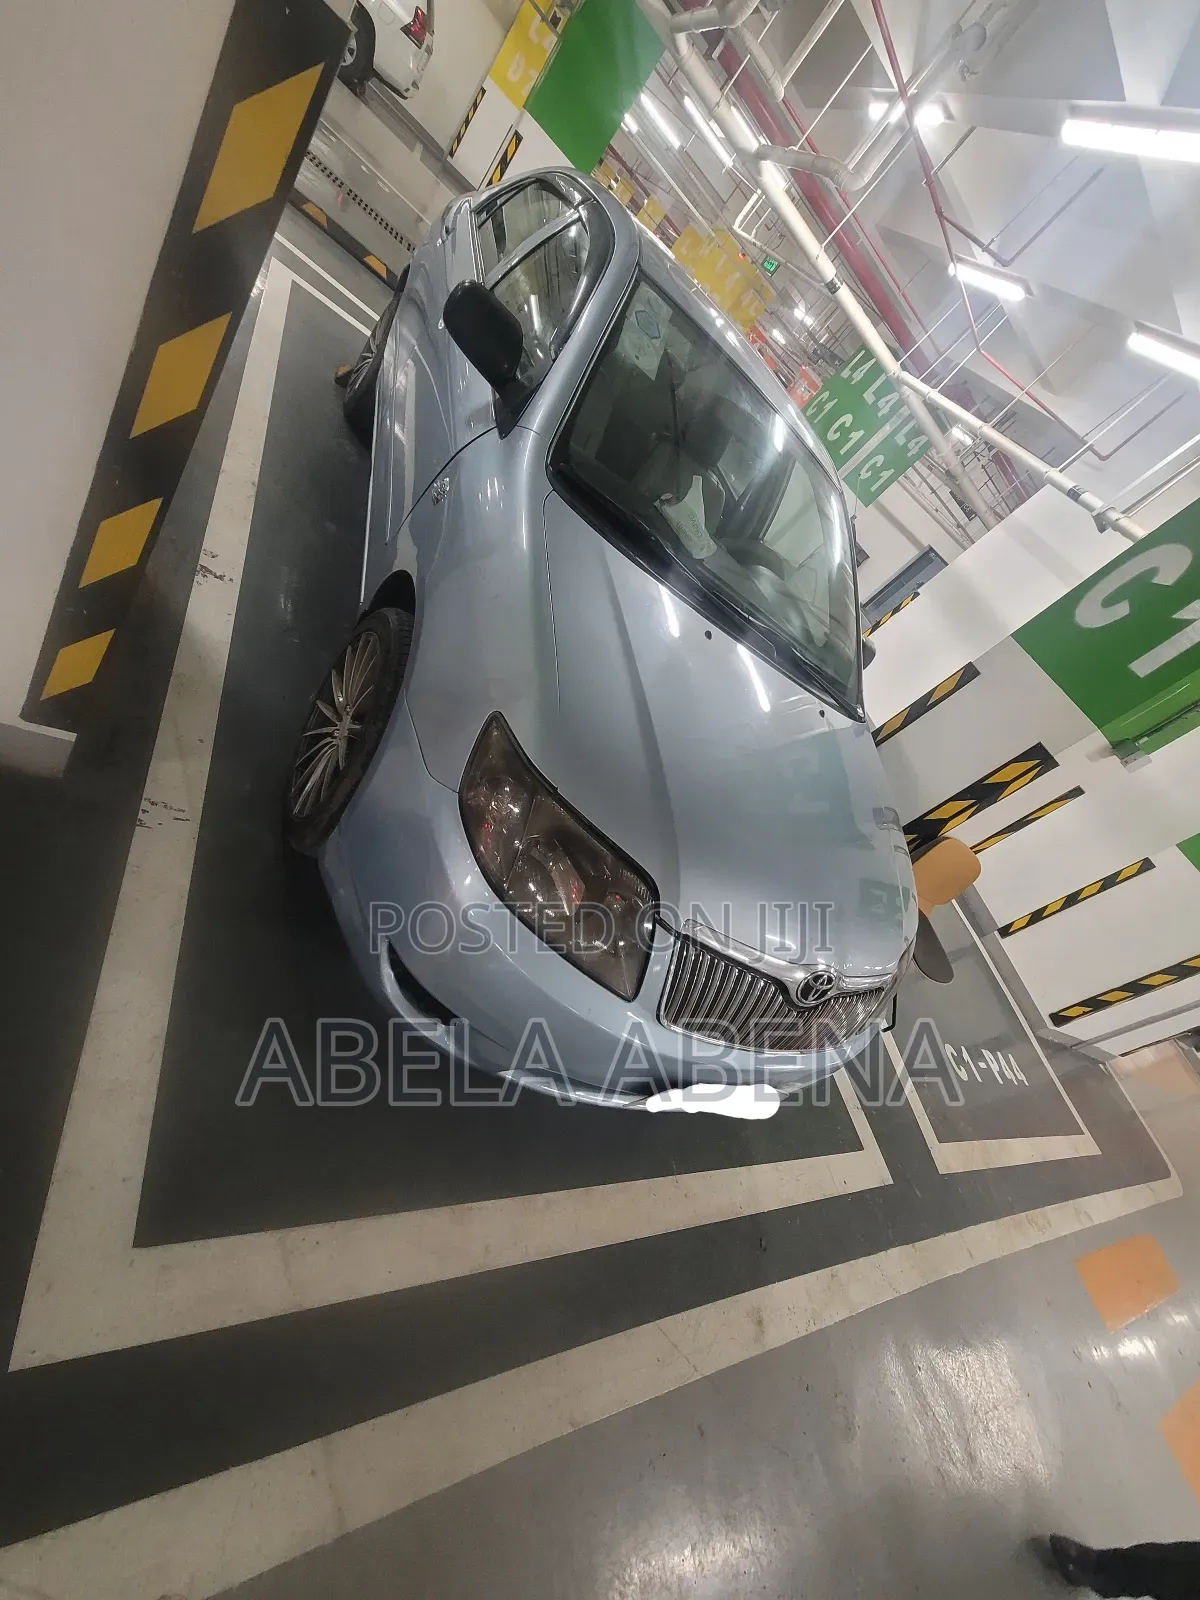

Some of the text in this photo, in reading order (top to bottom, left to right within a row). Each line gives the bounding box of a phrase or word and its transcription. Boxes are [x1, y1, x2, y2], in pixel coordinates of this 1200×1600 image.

[840, 350, 877, 385] L4
[805, 390, 839, 424] C1
[863, 373, 900, 418] L4
[827, 413, 866, 455] C1
[894, 418, 929, 458] L4
[859, 454, 895, 492] C1
[1075, 543, 1200, 678] C1
[944, 1043, 1030, 1087] C1-P44
